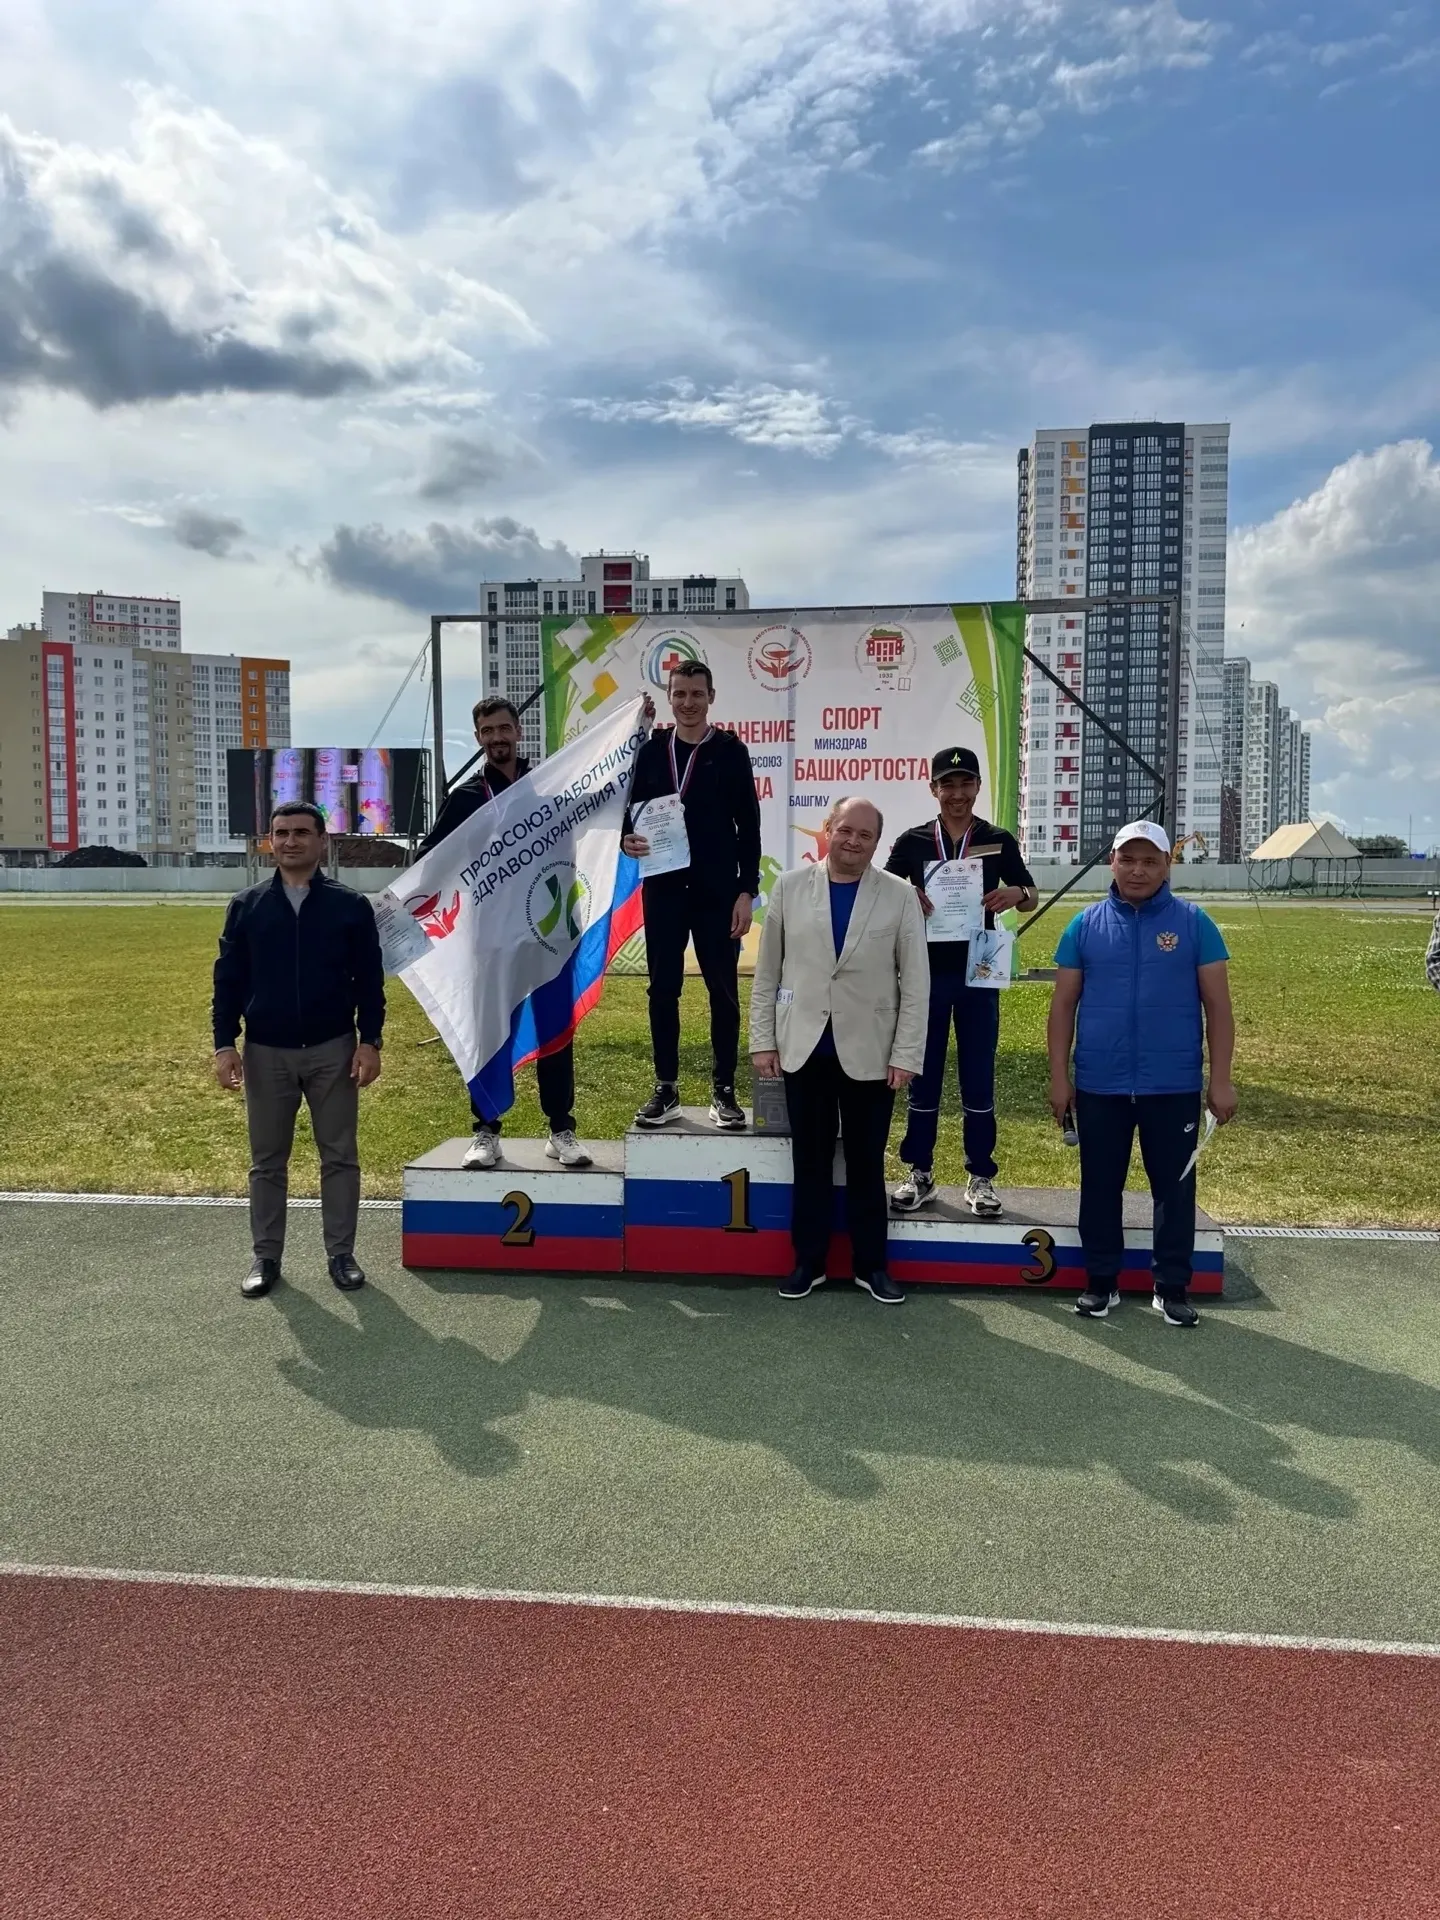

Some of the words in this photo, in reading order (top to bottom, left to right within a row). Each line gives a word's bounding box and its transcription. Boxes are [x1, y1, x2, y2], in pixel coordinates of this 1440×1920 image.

[814, 738, 868, 751] МИНЗДРАВ
[822, 706, 882, 731] СПОРТ
[750, 756, 782, 768] ФСОЮЗ
[794, 758, 931, 782] БАШКОРТОСТА
[459, 804, 553, 886] ПРОФСОЮЗ
[553, 726, 647, 812] РАБОТНИКОВ
[789, 795, 830, 808] БАШГМУ
[472, 782, 616, 906] ЗДРАВООХРАНЕНИЯ
[525, 872, 542, 926] клиническая
[541, 860, 570, 874] больница
[500, 1190, 535, 1246] 2
[720, 1168, 758, 1232] 1
[1020, 1228, 1057, 1284] 3
